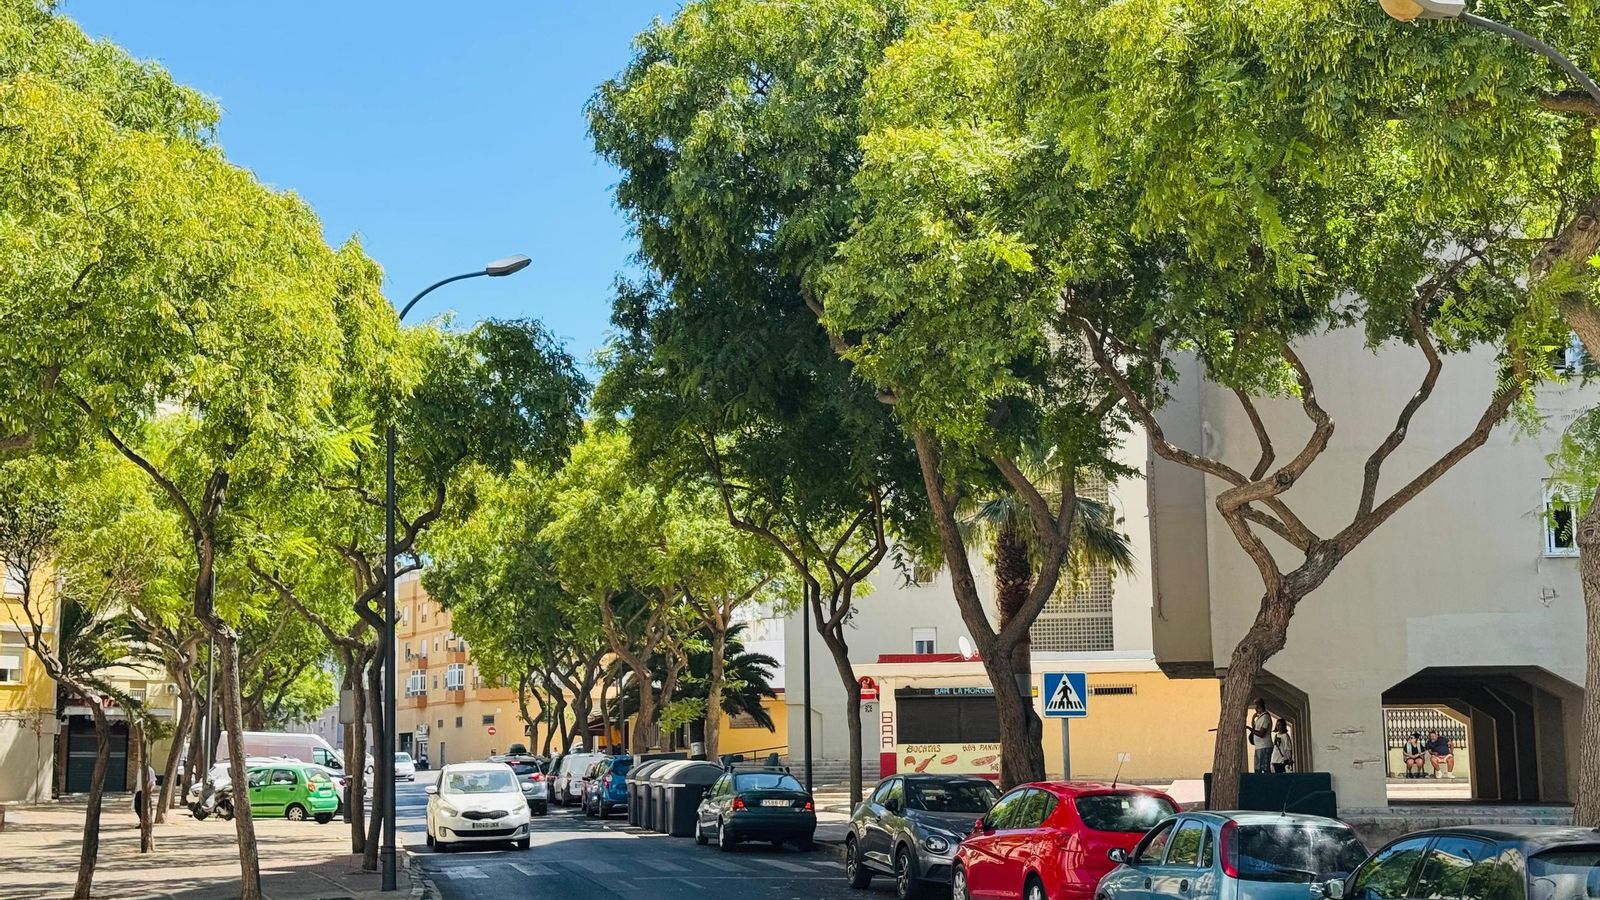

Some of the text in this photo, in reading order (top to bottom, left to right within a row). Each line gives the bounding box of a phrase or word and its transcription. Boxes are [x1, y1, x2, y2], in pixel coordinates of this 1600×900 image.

[934, 687, 950, 695] BAR
[953, 687, 963, 695] LA
[906, 744, 941, 753] BOCATAS
